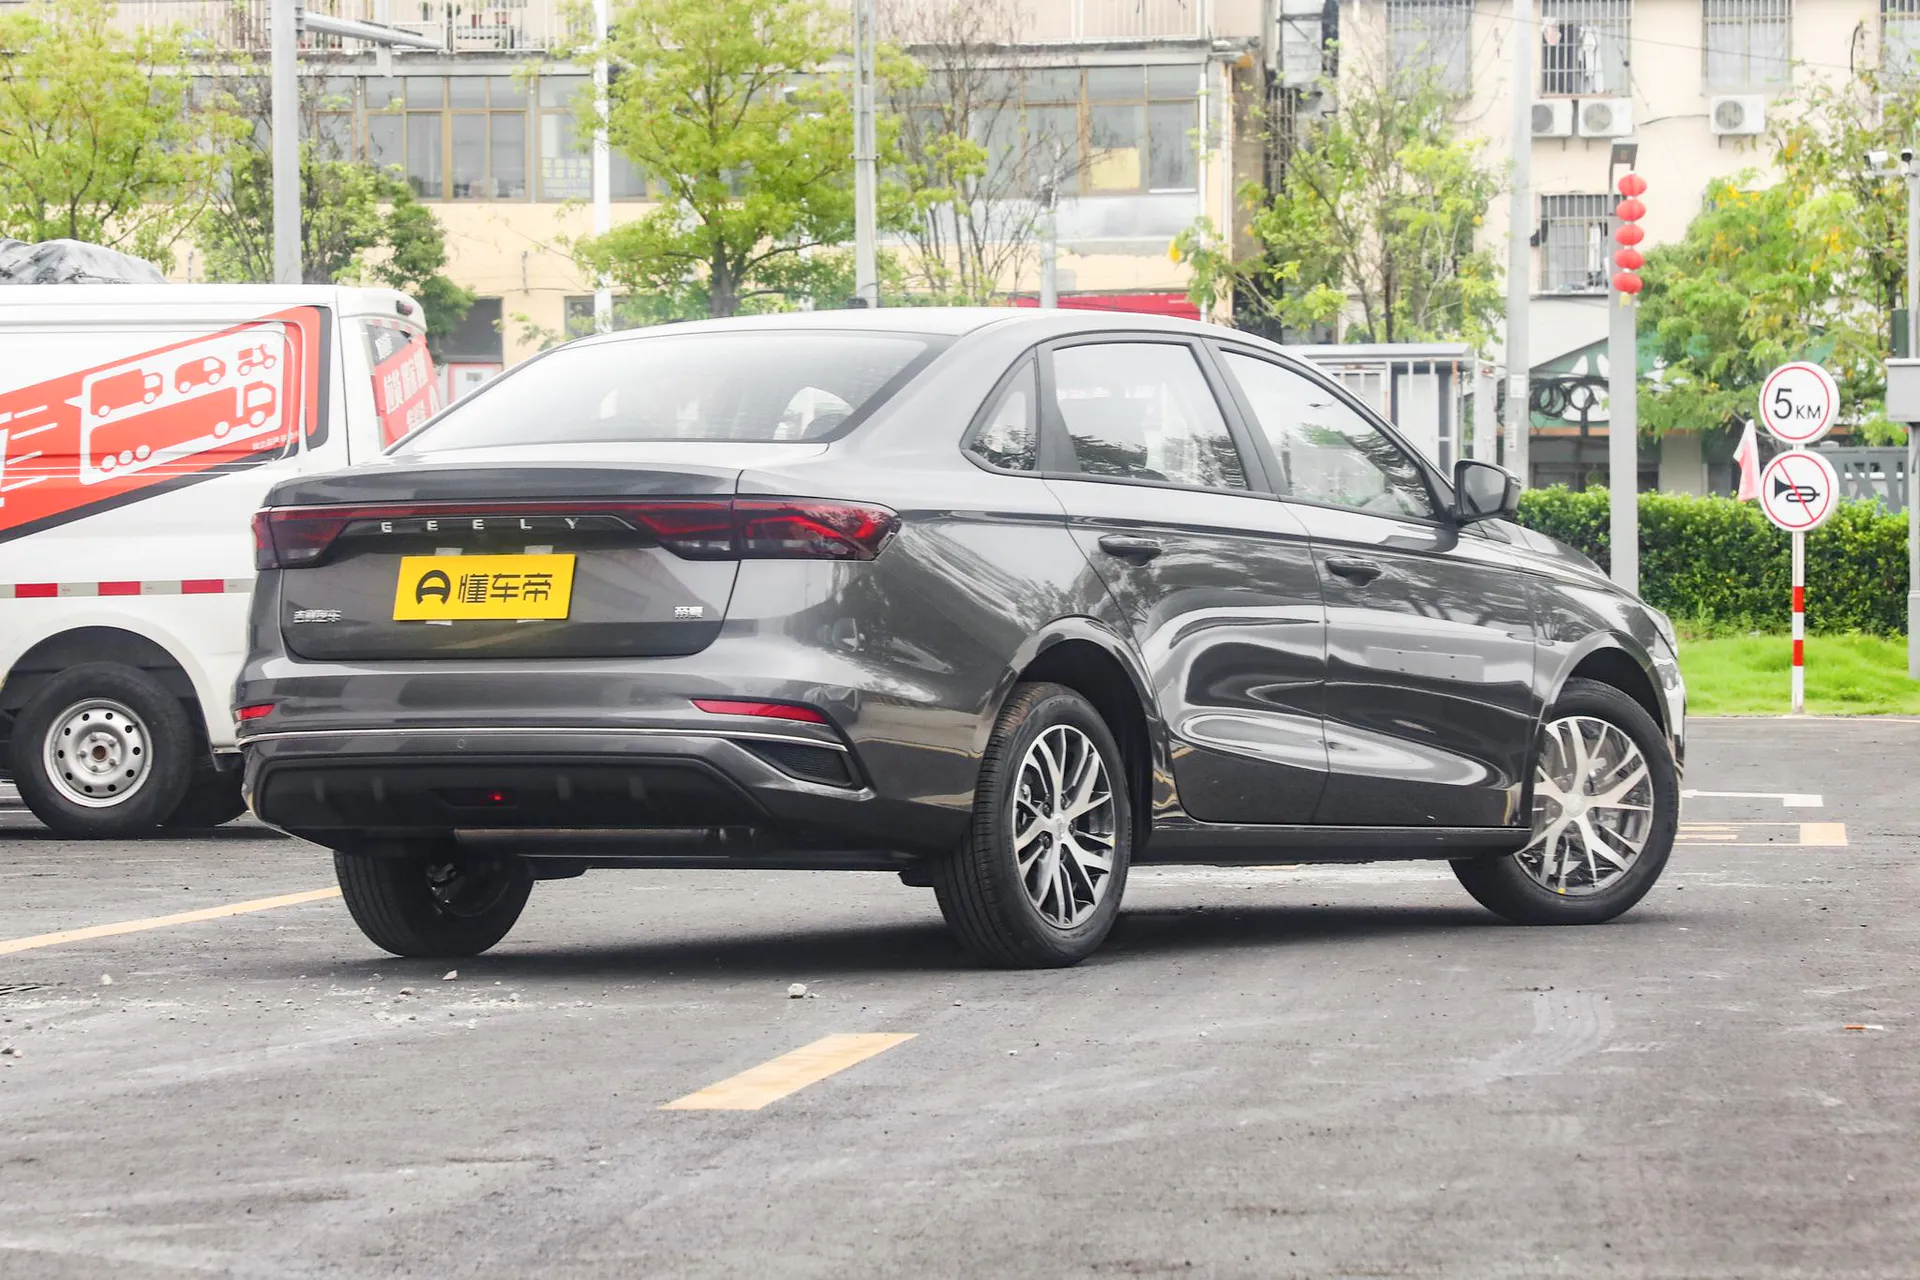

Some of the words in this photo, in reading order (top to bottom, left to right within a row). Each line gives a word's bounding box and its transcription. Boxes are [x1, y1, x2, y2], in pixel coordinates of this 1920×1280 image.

[380, 517, 579, 533] GEELY
[458, 573, 553, 603] 懂车帝
